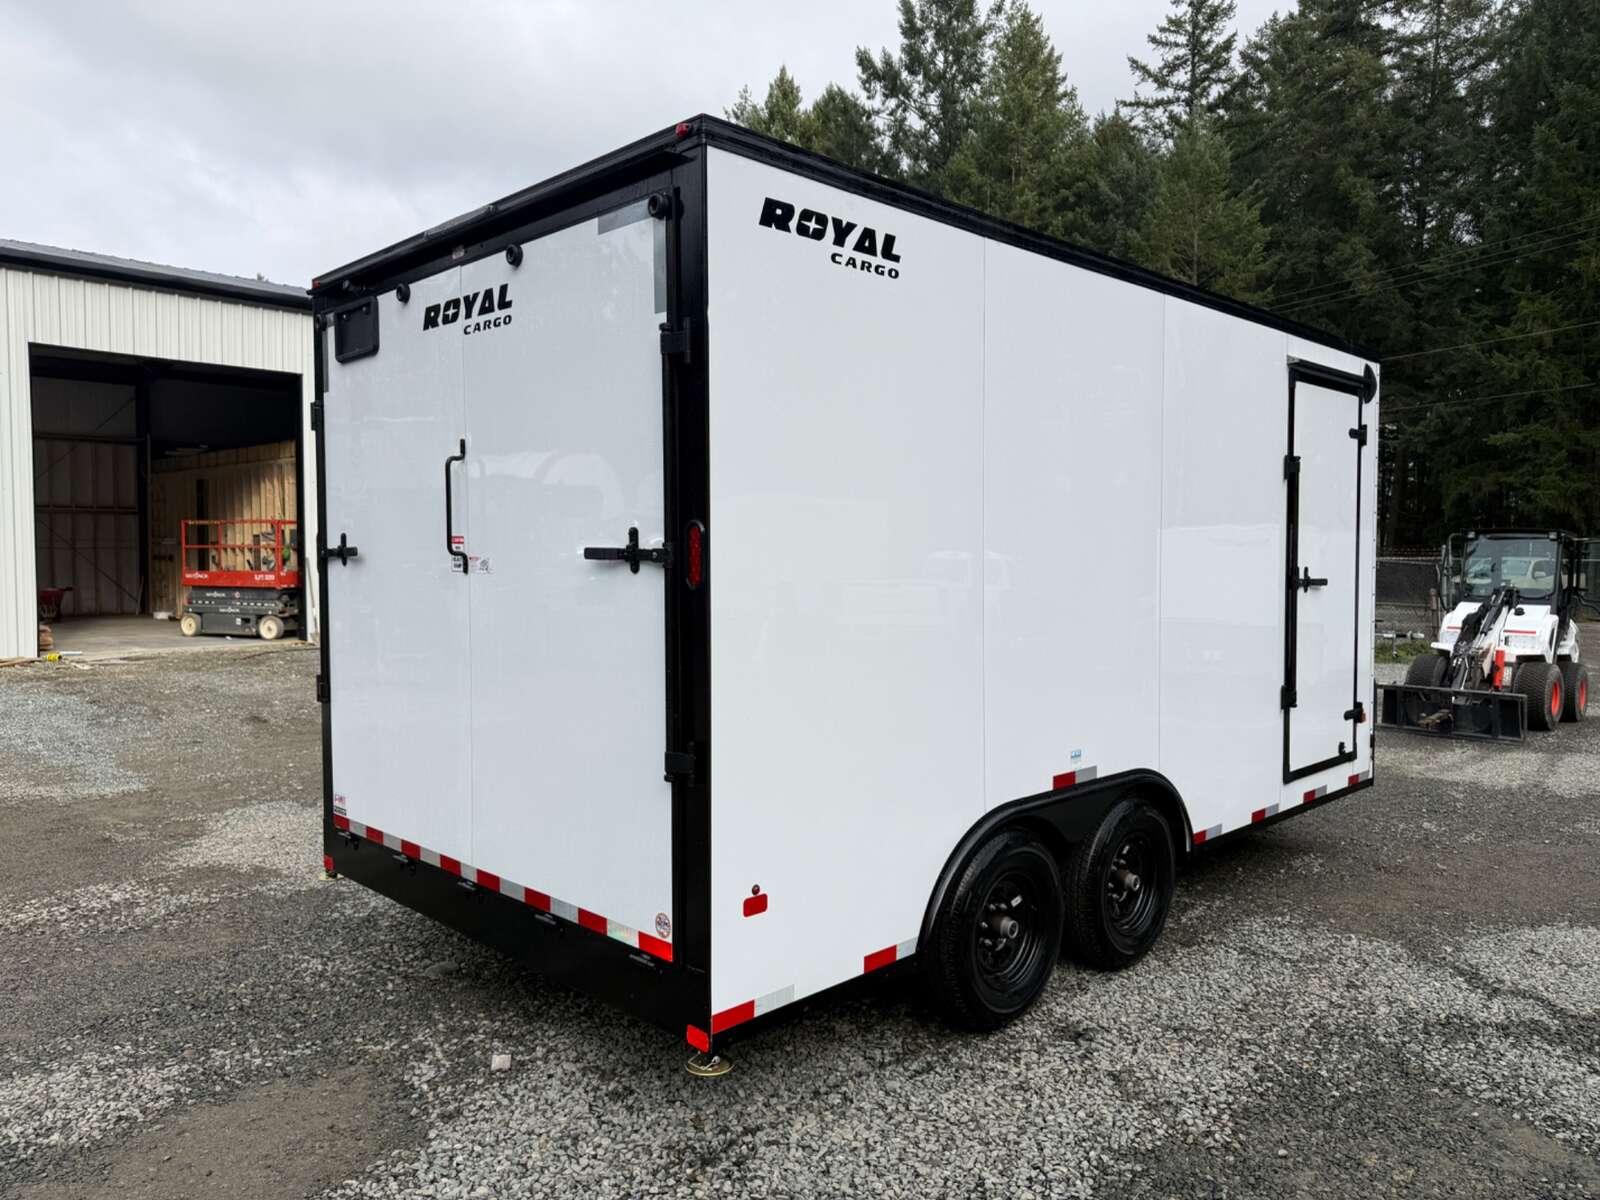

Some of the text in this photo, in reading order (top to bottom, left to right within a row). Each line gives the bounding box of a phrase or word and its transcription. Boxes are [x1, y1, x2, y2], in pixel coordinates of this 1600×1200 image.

[759, 197, 901, 263] ROYAL
[831, 253, 899, 279] CARGO
[423, 283, 513, 331] ROYAL
[463, 315, 512, 335] CARGO
